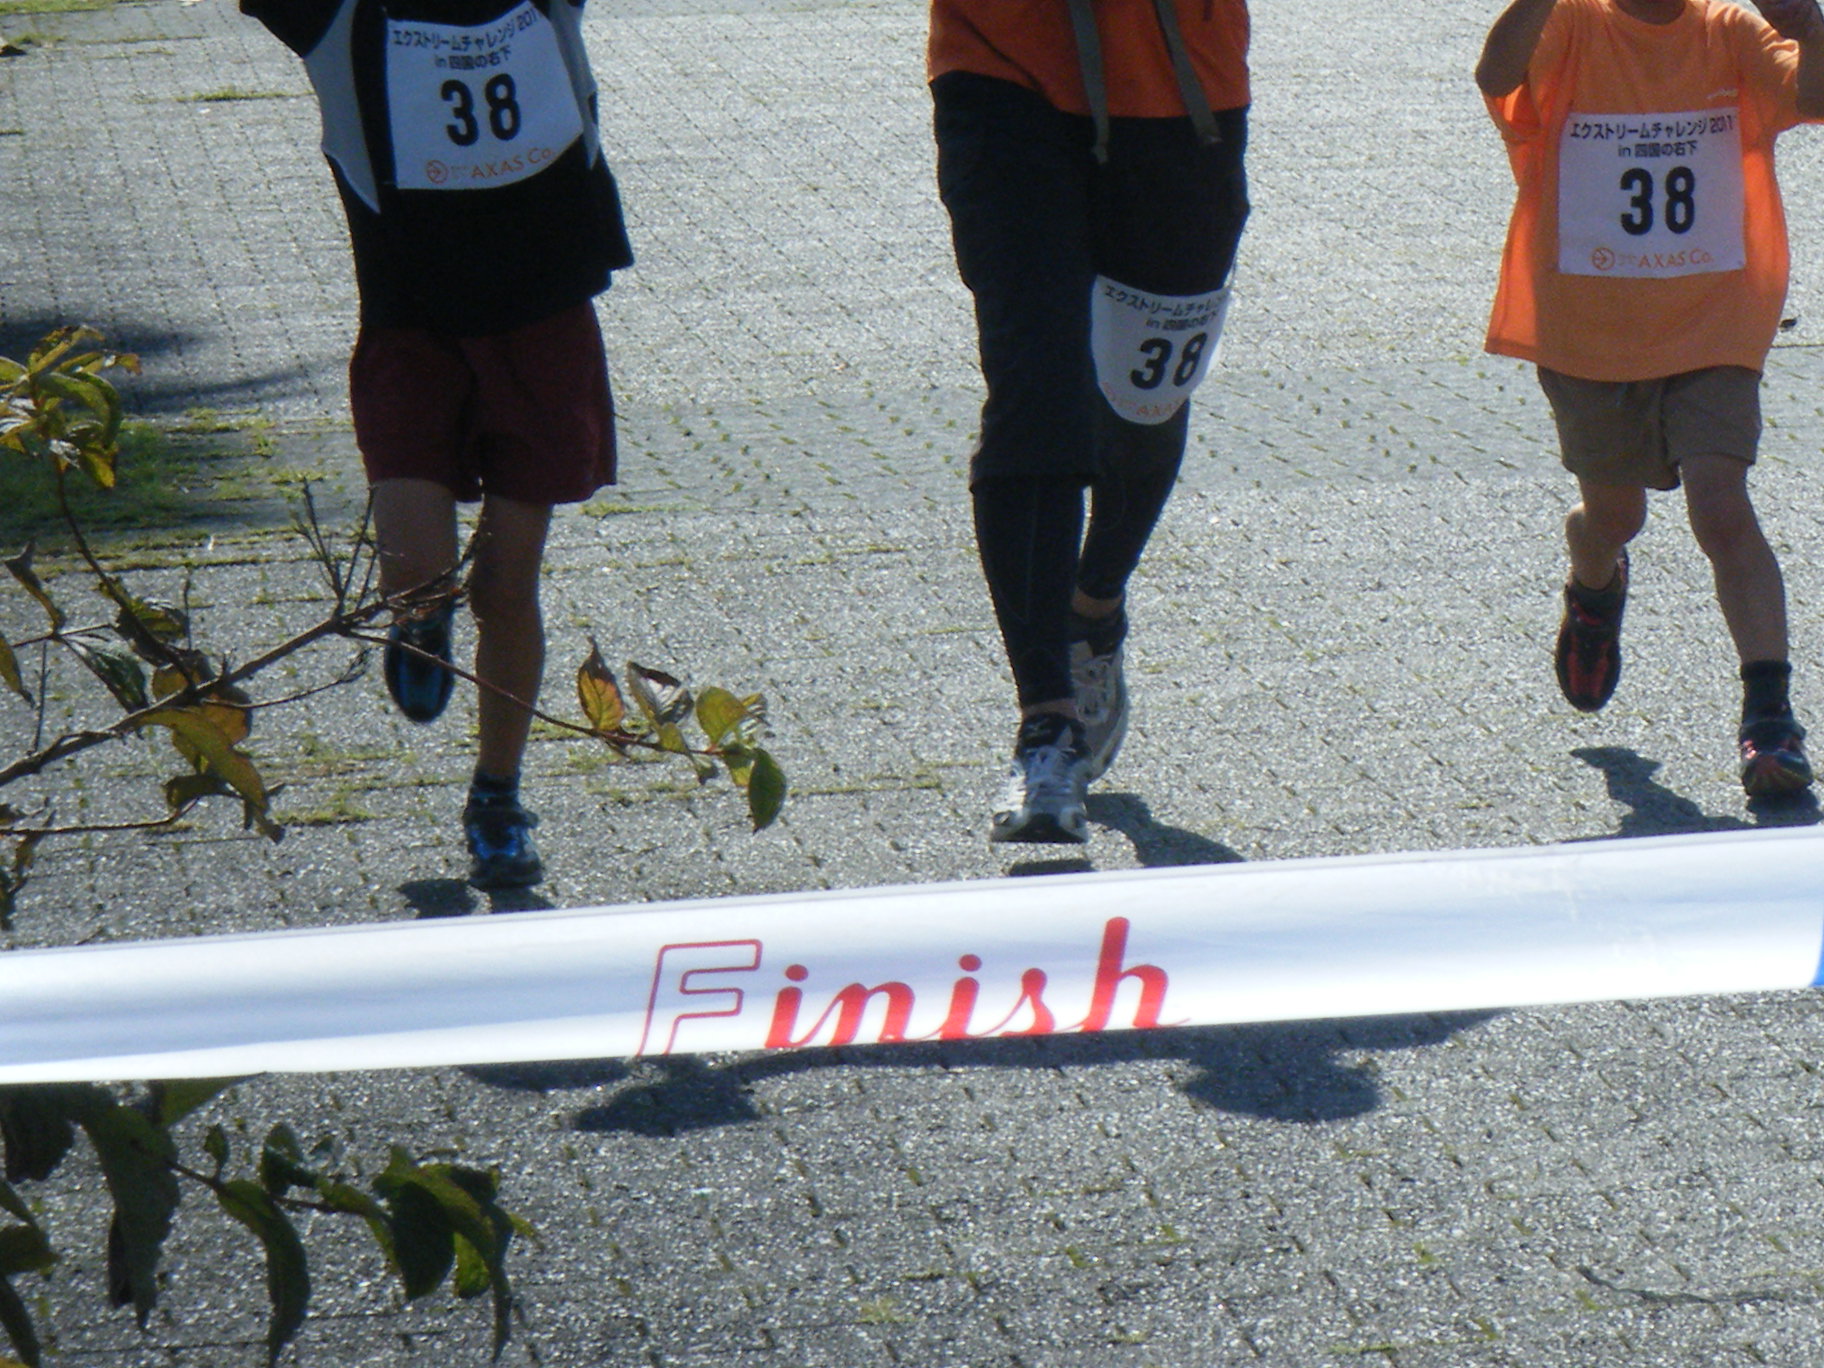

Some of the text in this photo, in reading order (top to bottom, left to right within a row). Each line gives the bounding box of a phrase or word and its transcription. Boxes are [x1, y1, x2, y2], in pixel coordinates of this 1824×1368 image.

[517, 8, 541, 32] 2011
[440, 73, 521, 147] 38
[1570, 115, 1734, 140] エクストリームチャレンジ 2011
[471, 155, 525, 179] AXAS
[1619, 166, 1696, 236] 38
[1638, 252, 1685, 269] AXAS
[1130, 332, 1208, 391] 38
[635, 916, 1193, 1056] Finish
